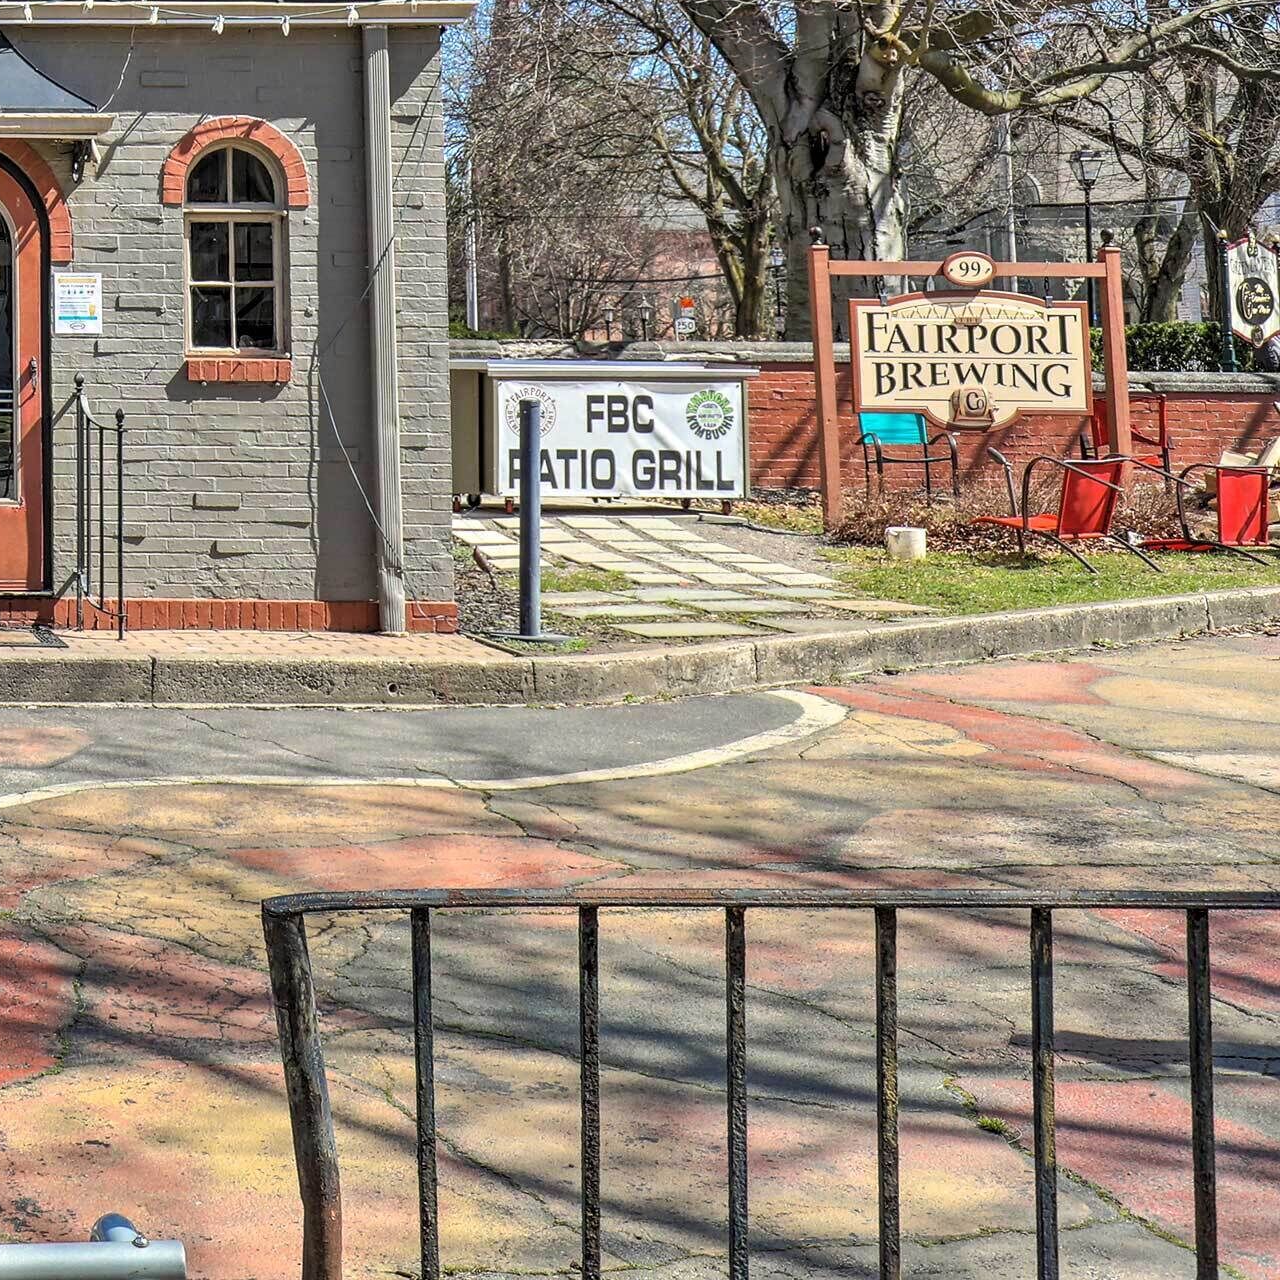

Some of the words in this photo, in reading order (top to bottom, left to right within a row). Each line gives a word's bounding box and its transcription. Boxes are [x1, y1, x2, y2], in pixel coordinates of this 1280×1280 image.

[959, 261, 981, 277] 99
[862, 311, 1077, 356] FAIRPORT
[510, 387, 552, 403] FAIRPORT
[874, 361, 1073, 399] BREWING
[586, 394, 655, 433] FBC
[686, 415, 735, 440] KOMBUCHA
[632, 450, 735, 491] GRILL
